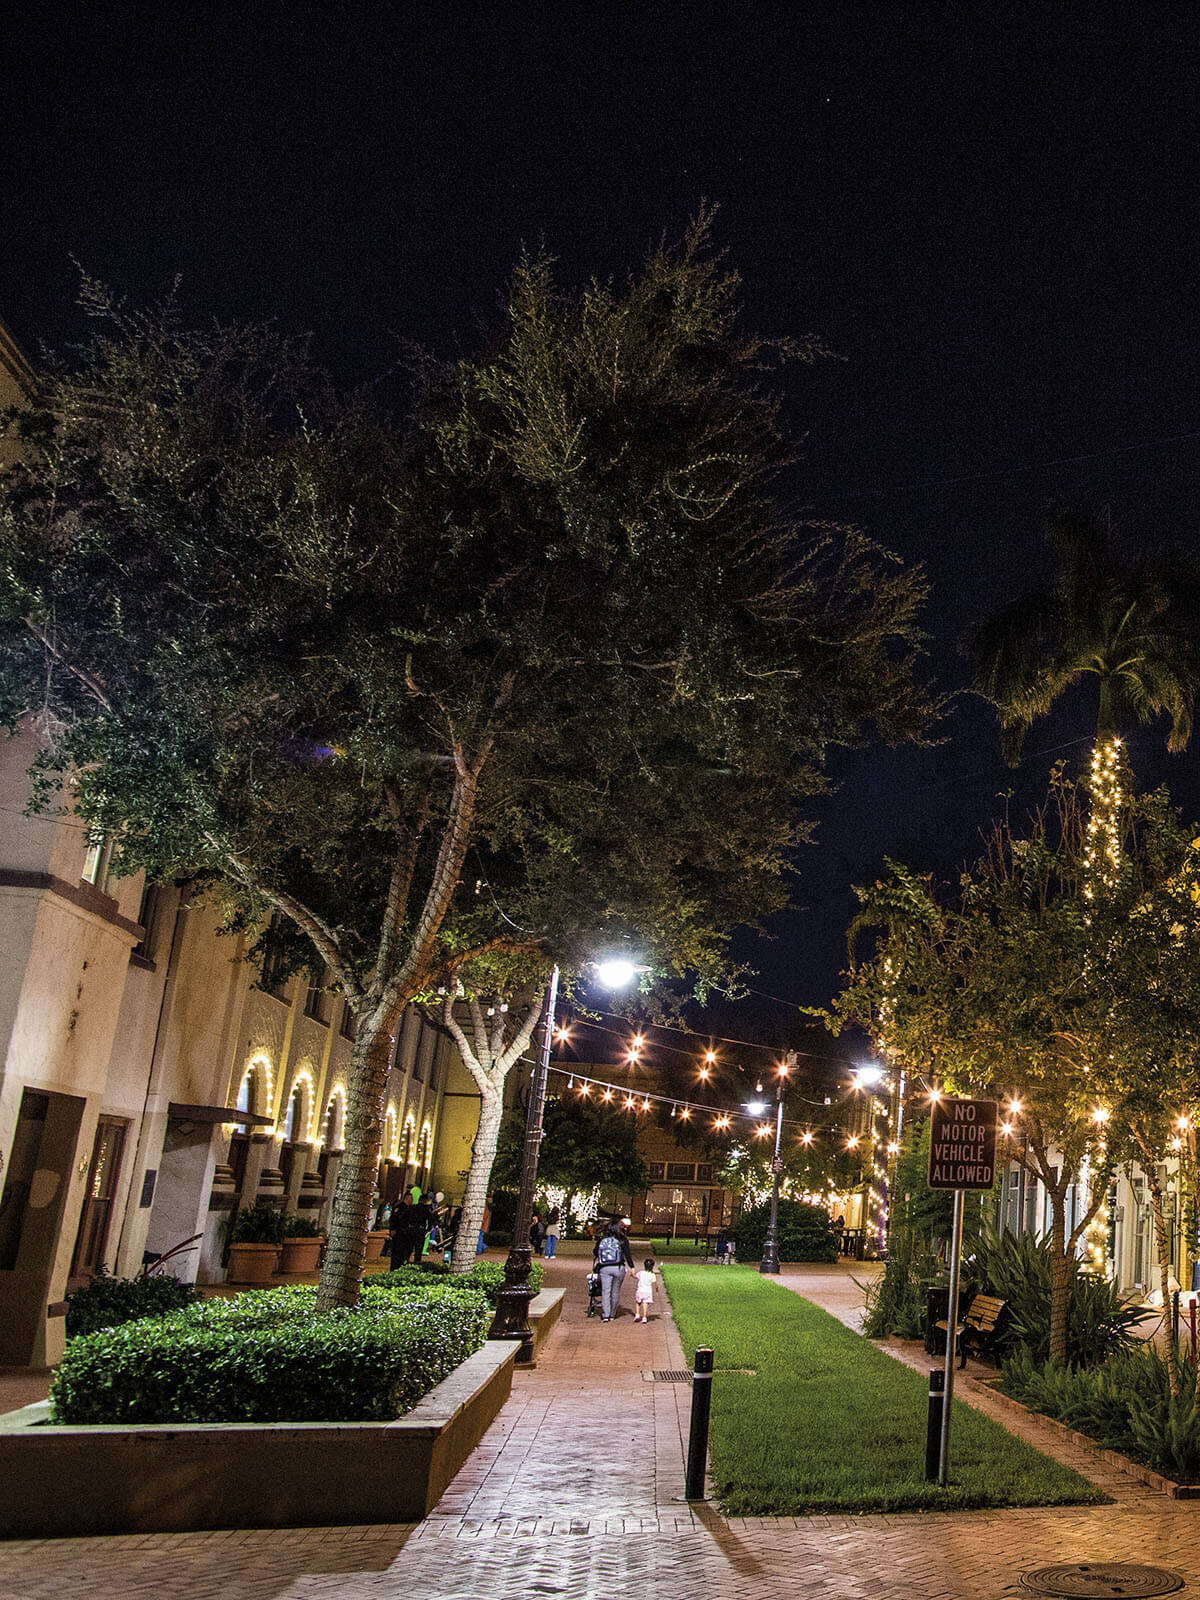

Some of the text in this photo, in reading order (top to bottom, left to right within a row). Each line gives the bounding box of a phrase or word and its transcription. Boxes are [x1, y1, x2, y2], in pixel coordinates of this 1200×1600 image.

[954, 1104, 976, 1121] NO
[941, 1124, 986, 1142] MOTOR
[934, 1143, 985, 1162] VEHICLE
[932, 1165, 991, 1183] ALLOWED
